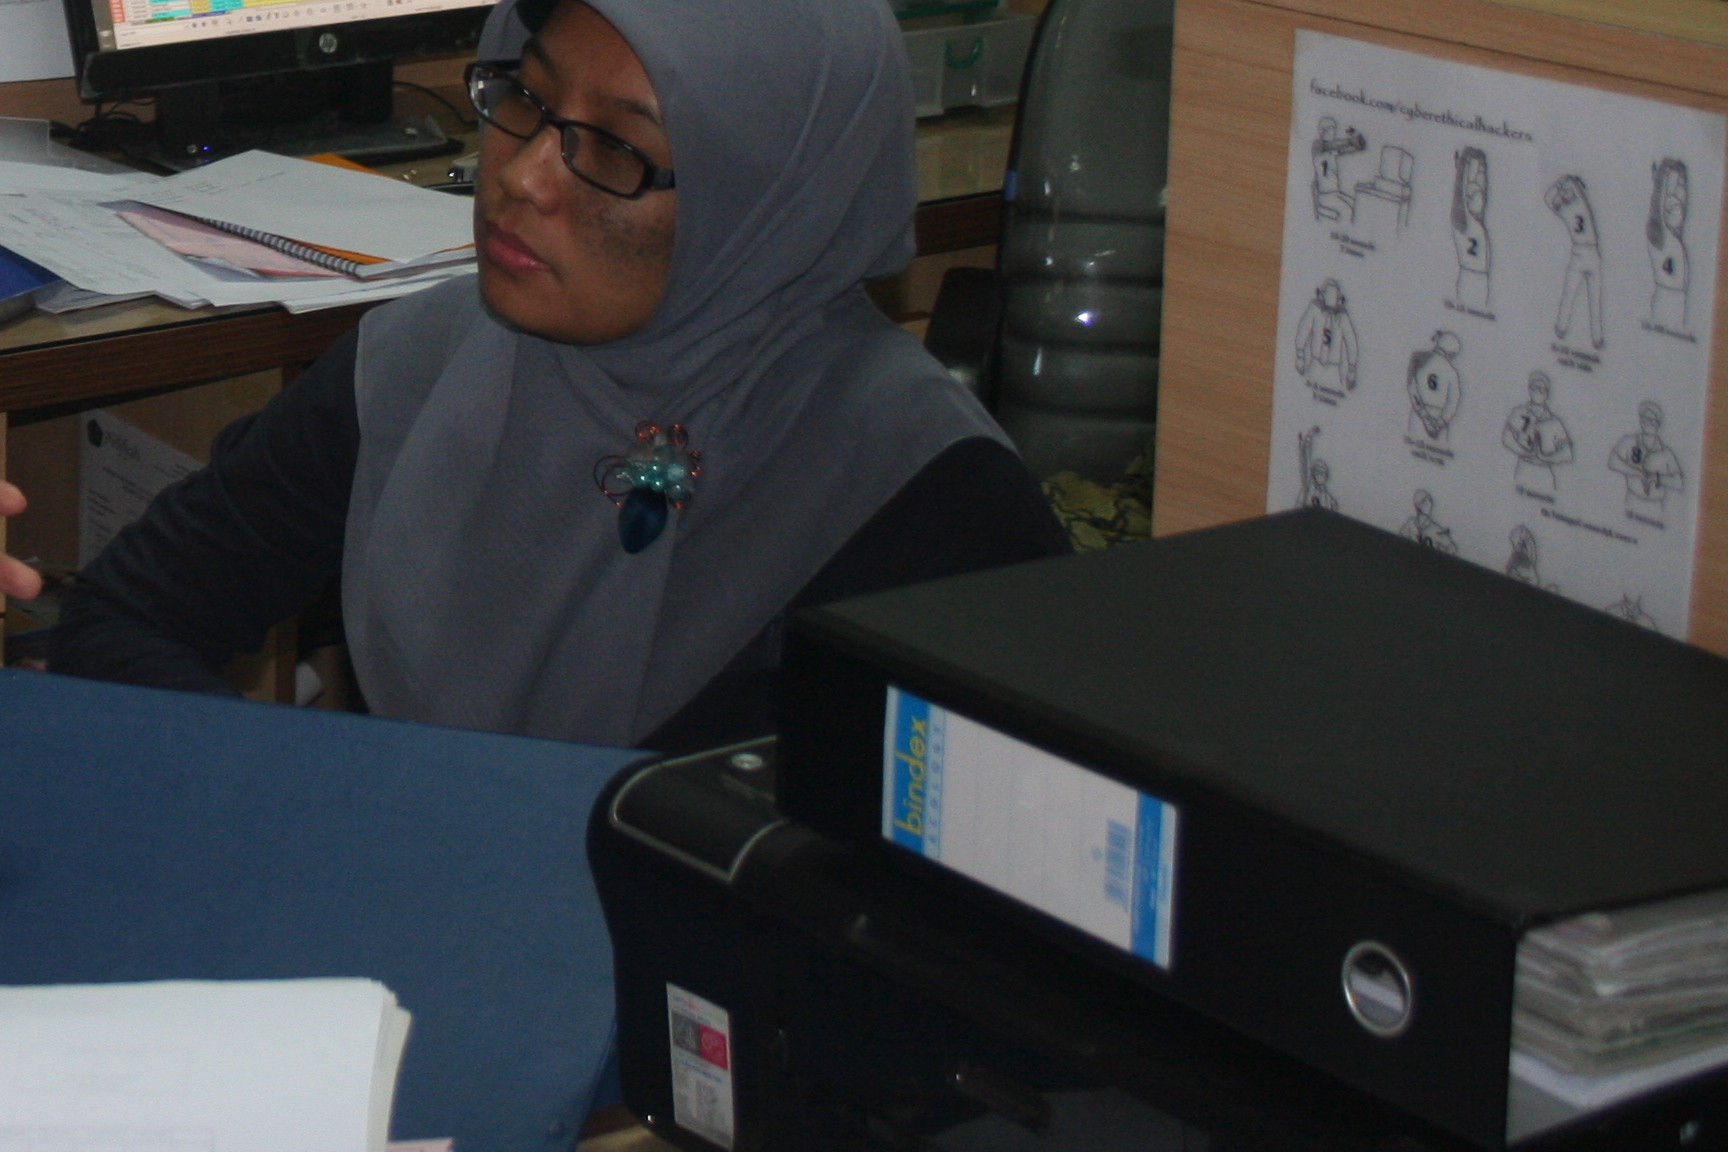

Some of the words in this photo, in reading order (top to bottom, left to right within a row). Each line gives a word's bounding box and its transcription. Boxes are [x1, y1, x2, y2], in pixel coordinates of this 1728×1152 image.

[1574, 215, 1584, 233] 3
[1467, 237, 1478, 257] 2
[1662, 257, 1673, 275] 4
[1323, 328, 1332, 346] 5
[1427, 373, 1438, 391] 6
[1631, 446, 1642, 465] 8
[893, 716, 928, 835] bindex
